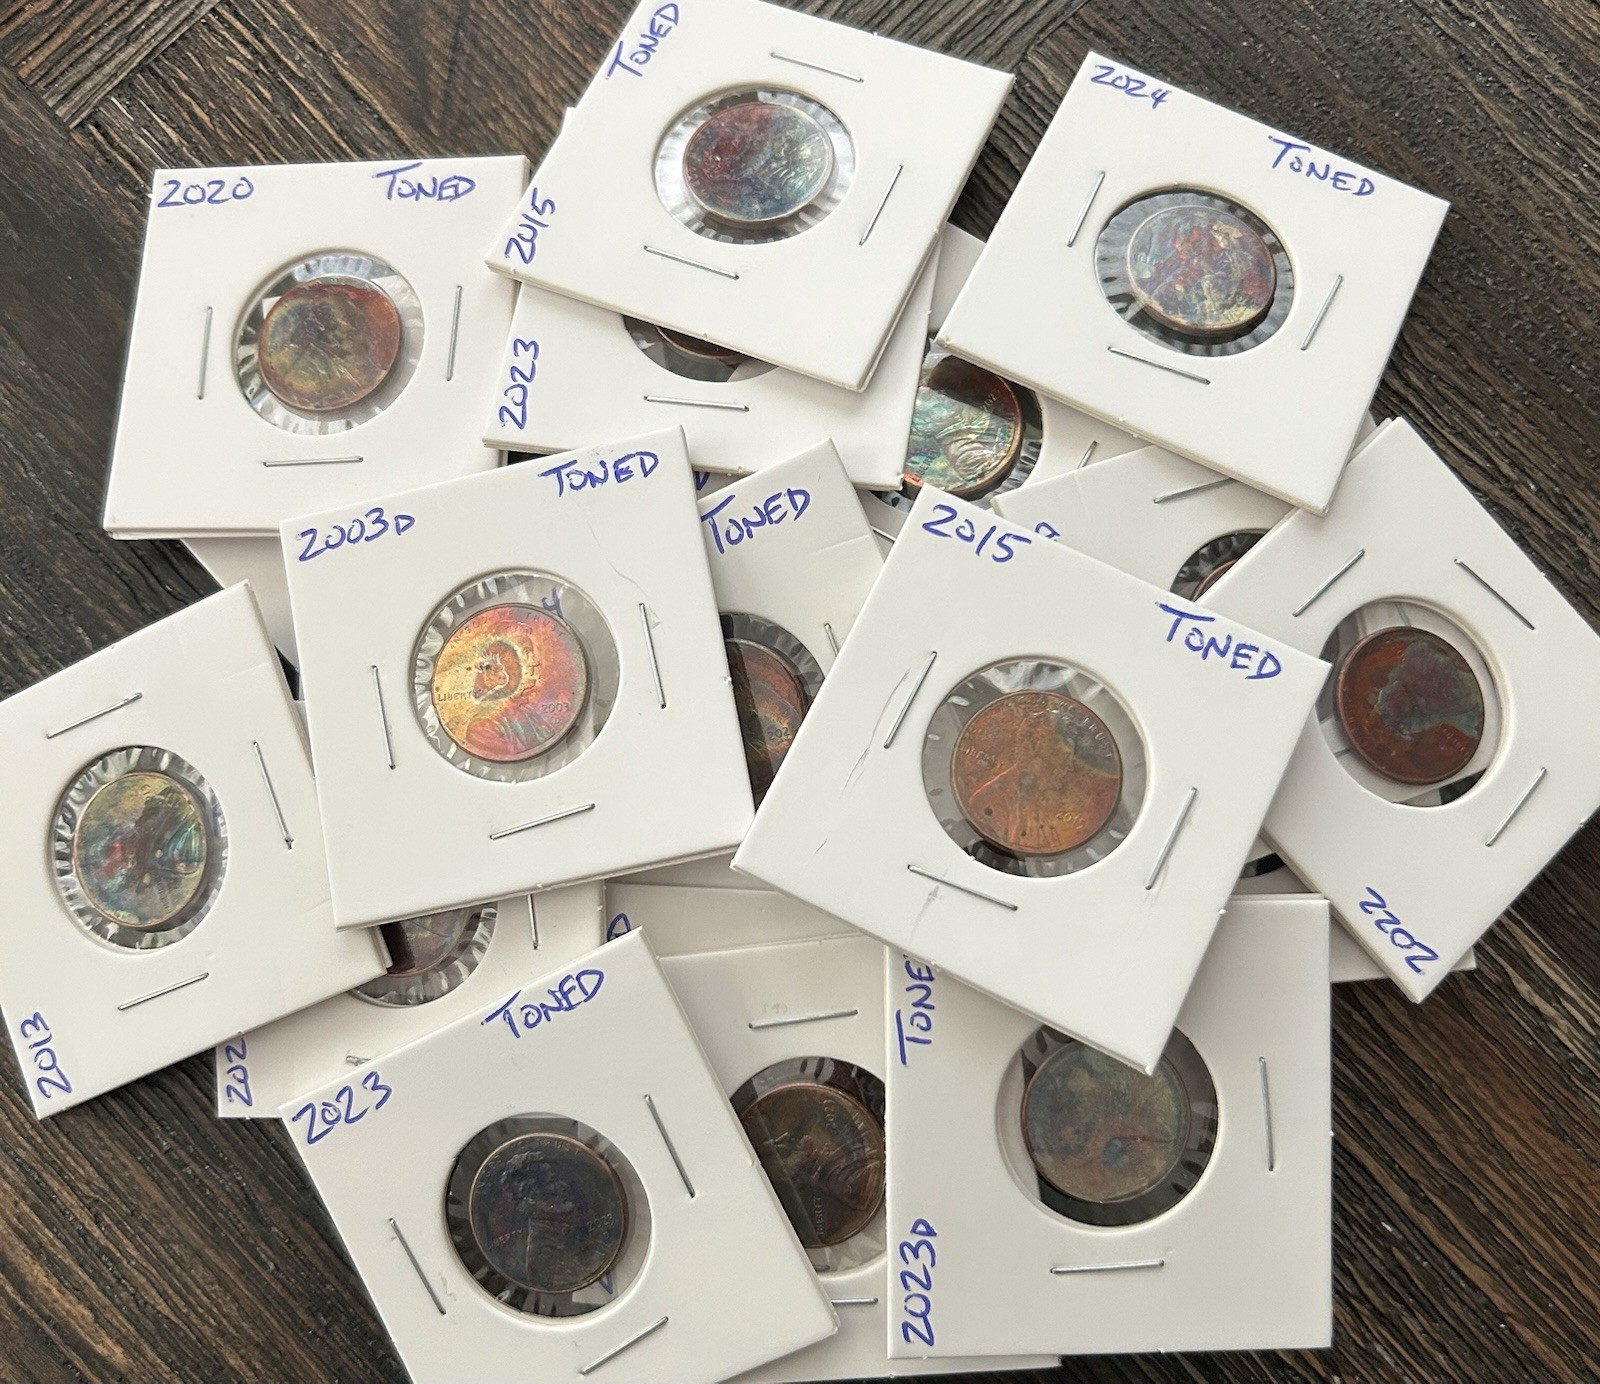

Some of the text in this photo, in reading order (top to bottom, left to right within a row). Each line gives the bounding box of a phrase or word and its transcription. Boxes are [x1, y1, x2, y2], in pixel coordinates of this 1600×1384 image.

[504, 2, 680, 264] 2015 TONED
[1090, 64, 1375, 197] 2024 TONED
[157, 162, 476, 208] 2020 TONED
[498, 338, 539, 429] 2023
[298, 507, 415, 561] 2003D
[540, 450, 660, 495] TONED
[701, 488, 811, 554] TONED
[921, 503, 1282, 680] 2015 TONED
[541, 702, 570, 715] 2003
[767, 726, 791, 741] 202
[1358, 887, 1439, 974] 2022
[20, 1011, 73, 1098] 2013
[292, 968, 605, 1144] 2023 TONED
[895, 953, 936, 1346] 2023D TONE
